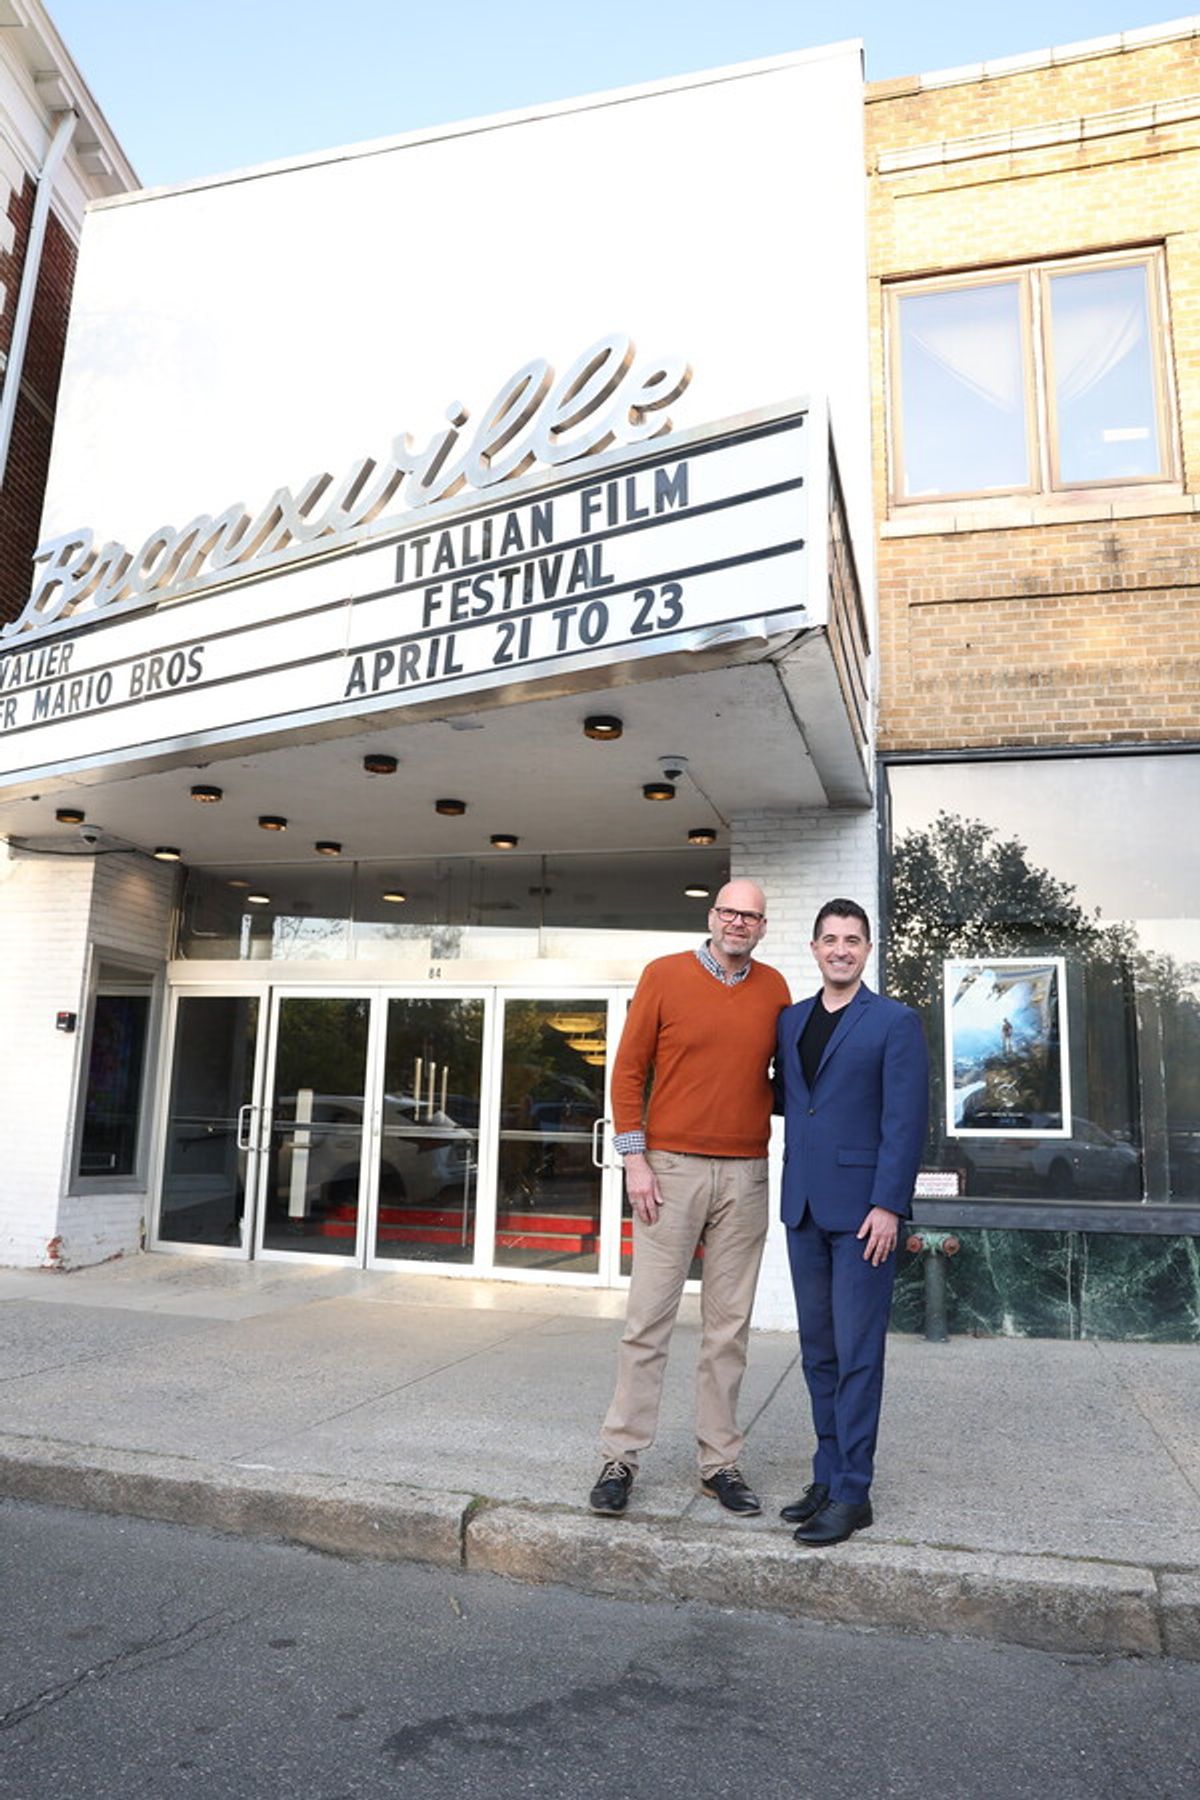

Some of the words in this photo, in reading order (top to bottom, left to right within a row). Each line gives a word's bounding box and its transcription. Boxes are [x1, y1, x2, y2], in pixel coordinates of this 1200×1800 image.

[1, 333, 693, 637] Bronxville
[395, 501, 554, 583] ITALIAN
[580, 462, 689, 533] FILM
[344, 634, 463, 697] APRIL
[492, 617, 531, 665] 21
[552, 601, 609, 651] TO
[630, 582, 684, 635] 23
[422, 544, 614, 628] FESTIVAL
[32, 671, 113, 721] MARIO
[129, 646, 205, 698] BROS
